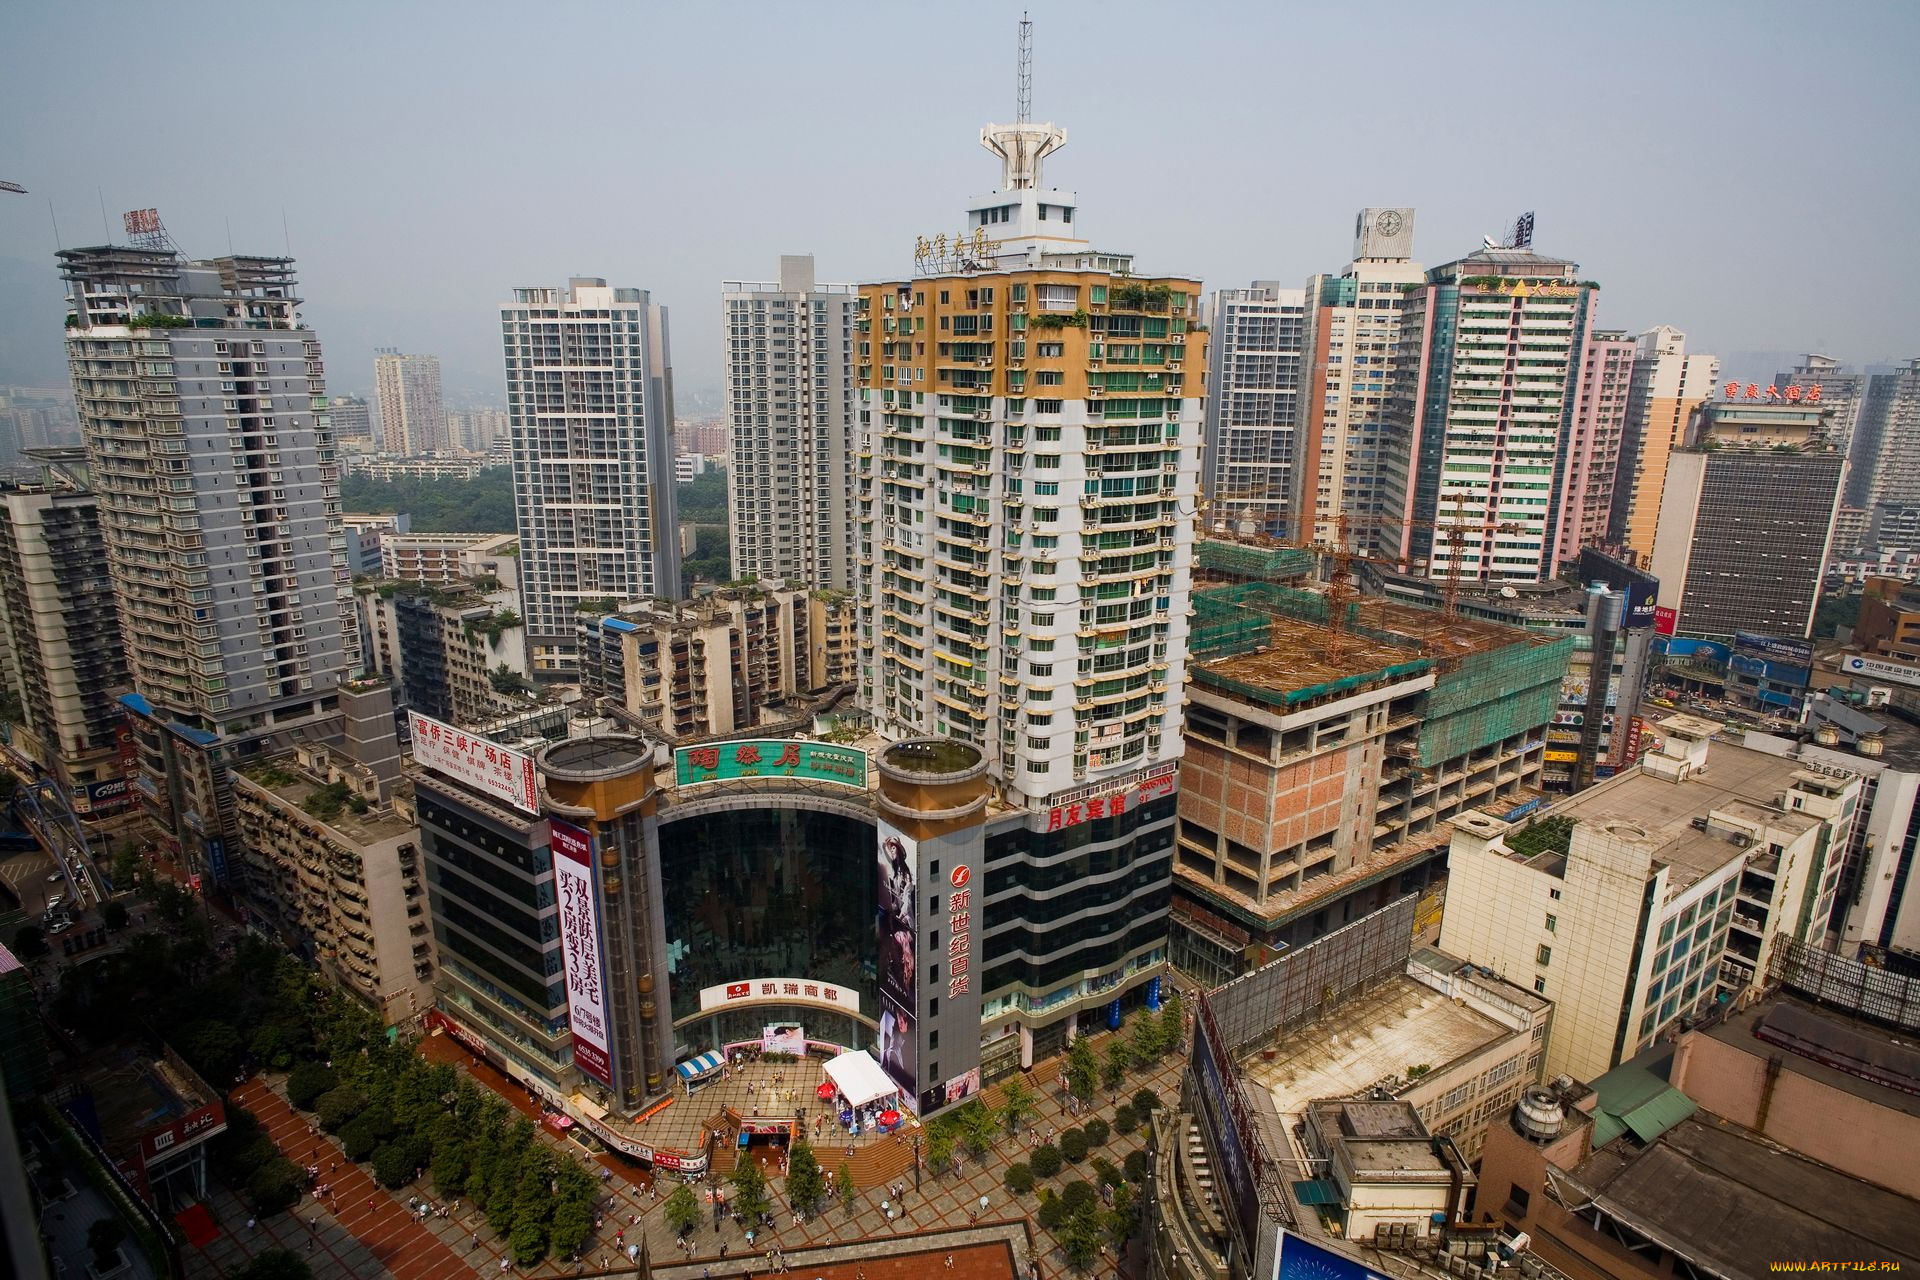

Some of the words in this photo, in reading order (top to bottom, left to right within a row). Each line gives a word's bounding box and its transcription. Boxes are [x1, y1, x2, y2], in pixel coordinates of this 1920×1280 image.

[1724, 381, 1822, 400] 重庆大酒店
[417, 719, 511, 770] 富侨三峡广场店
[688, 744, 802, 772] 陶然居
[559, 868, 583, 996] 买2房变3房
[574, 875, 600, 1005] 双景跃层美宅
[949, 888, 971, 1000] 新世纪百货
[762, 983, 838, 1000] 凯瑞商都
